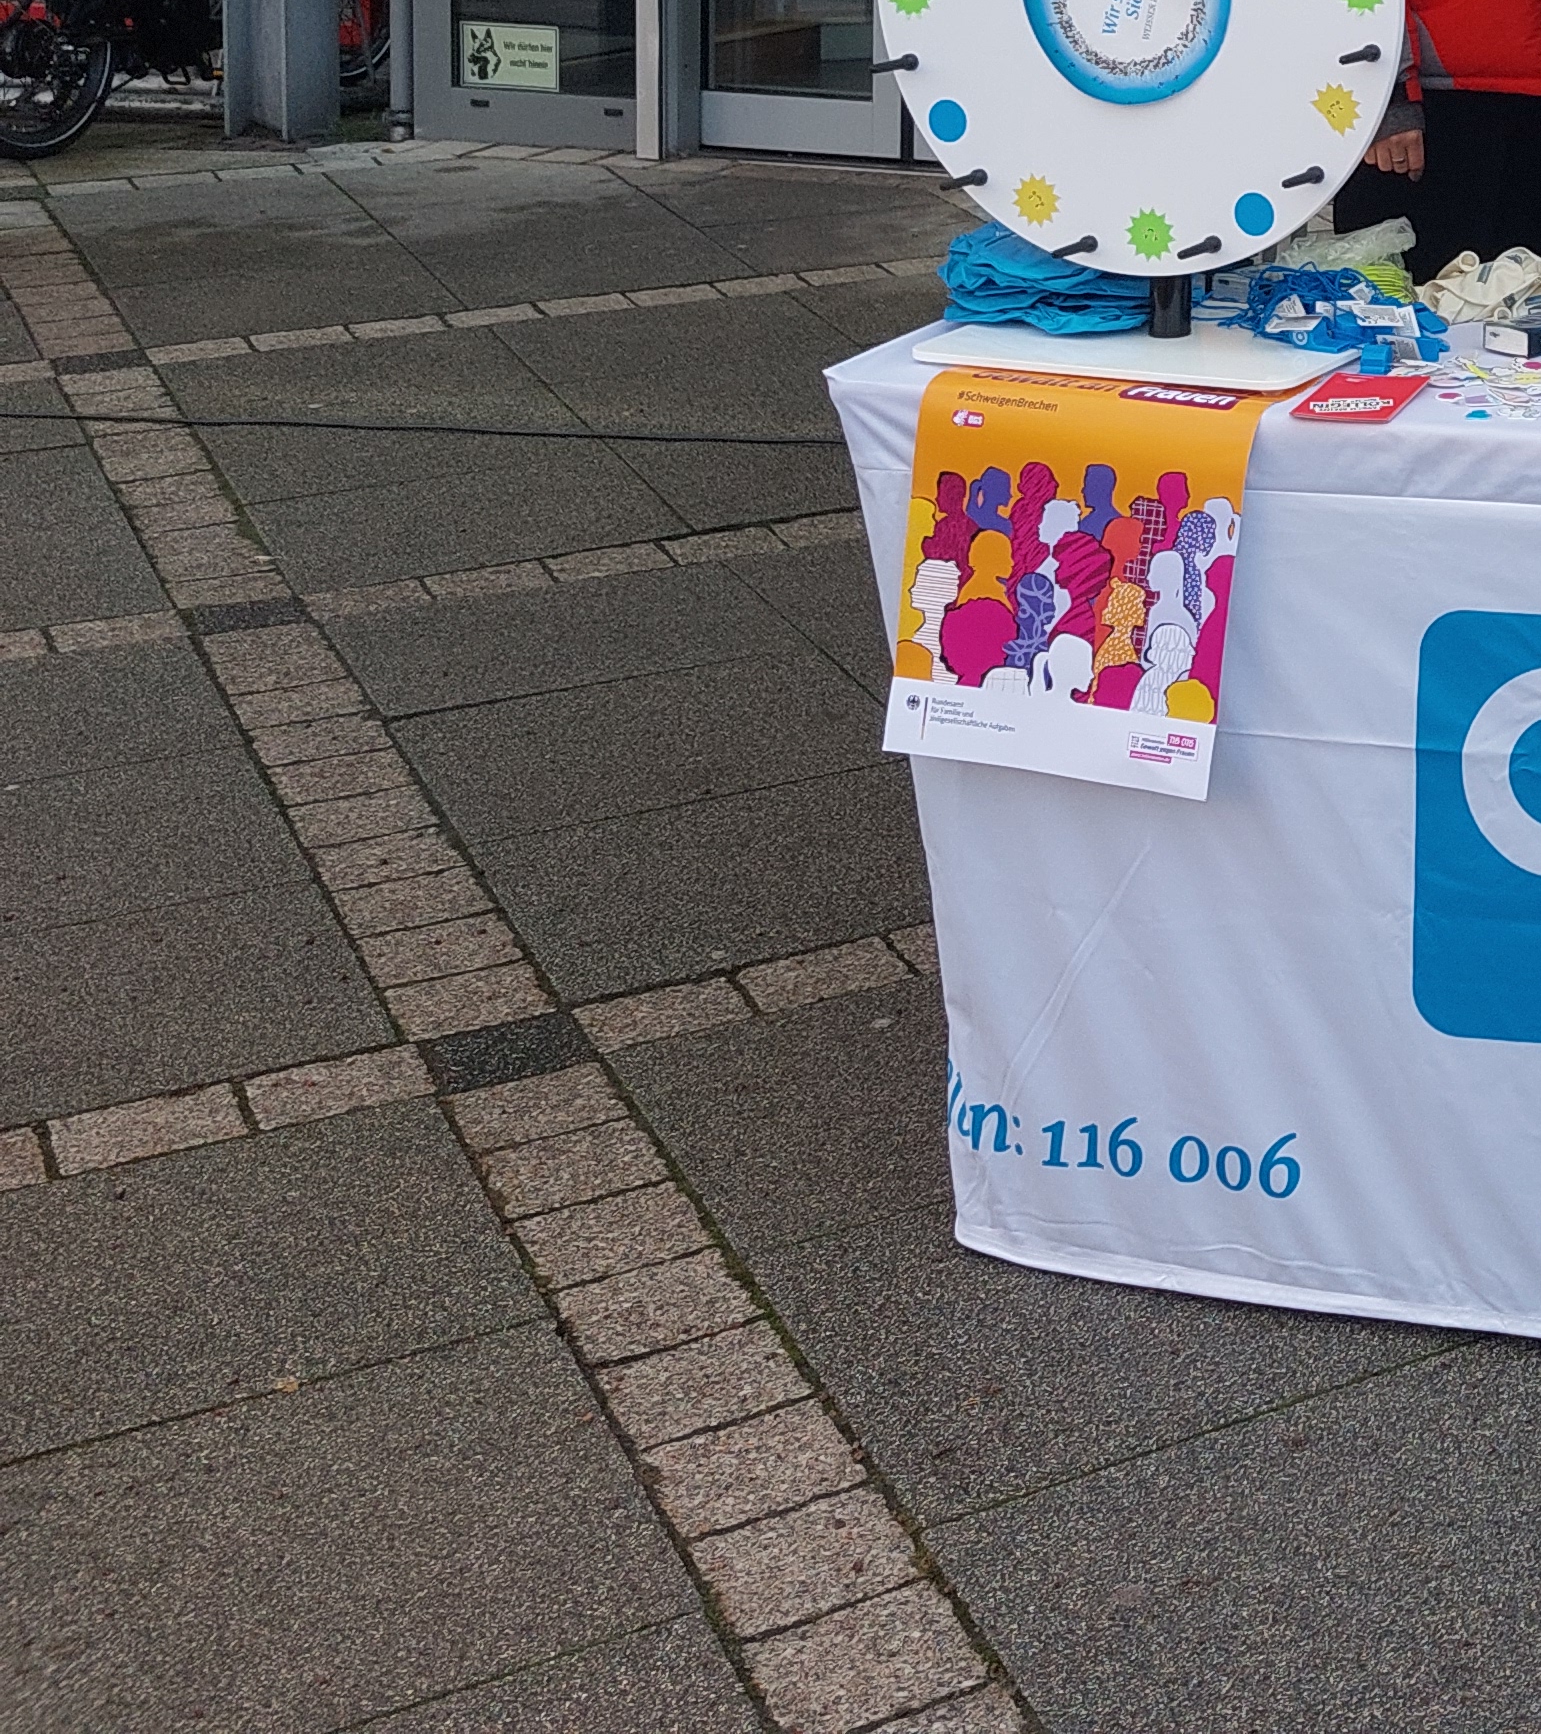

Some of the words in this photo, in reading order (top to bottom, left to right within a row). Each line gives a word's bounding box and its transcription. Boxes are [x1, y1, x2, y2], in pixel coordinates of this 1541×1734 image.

[1102, 7, 1120, 36] Wir
[957, 390, 1059, 413] #SchweigenBrechen
[1126, 385, 1239, 407] Frauen
[1042, 1116, 1144, 1178] 116
[1169, 1132, 1301, 1198] 006
